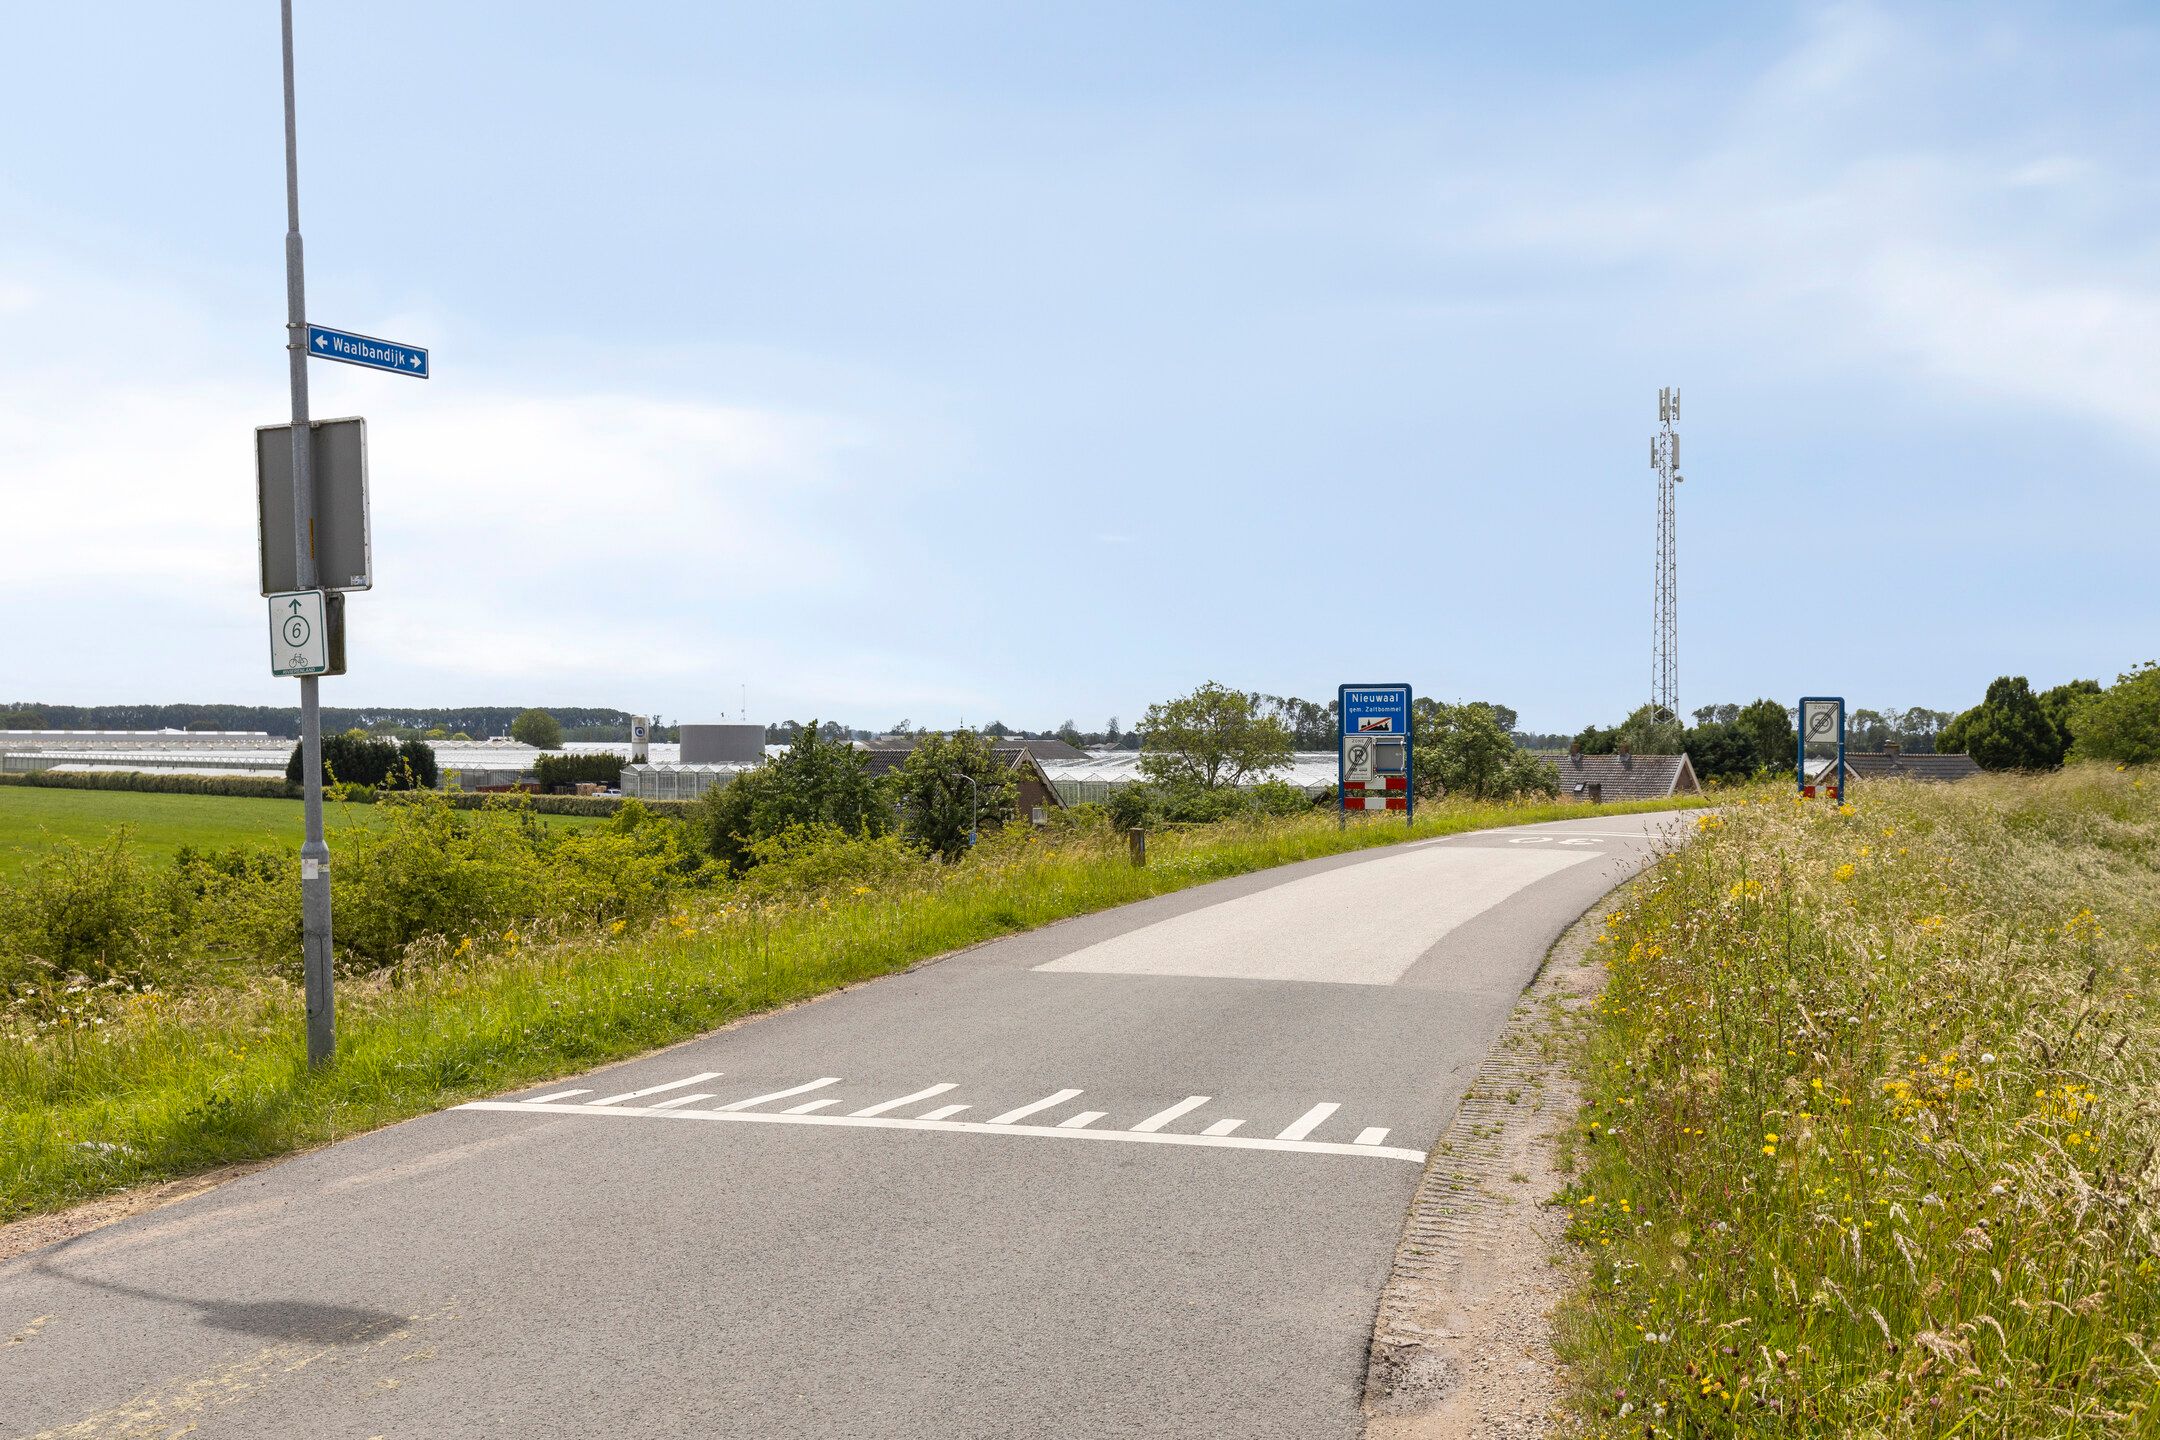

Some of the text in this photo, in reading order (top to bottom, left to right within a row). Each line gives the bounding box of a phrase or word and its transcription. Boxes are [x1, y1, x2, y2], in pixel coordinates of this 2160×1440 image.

[333, 336, 405, 367] Waalbandijk
[292, 622, 302, 639] 6
[1352, 693, 1399, 702] Nieuwaal
